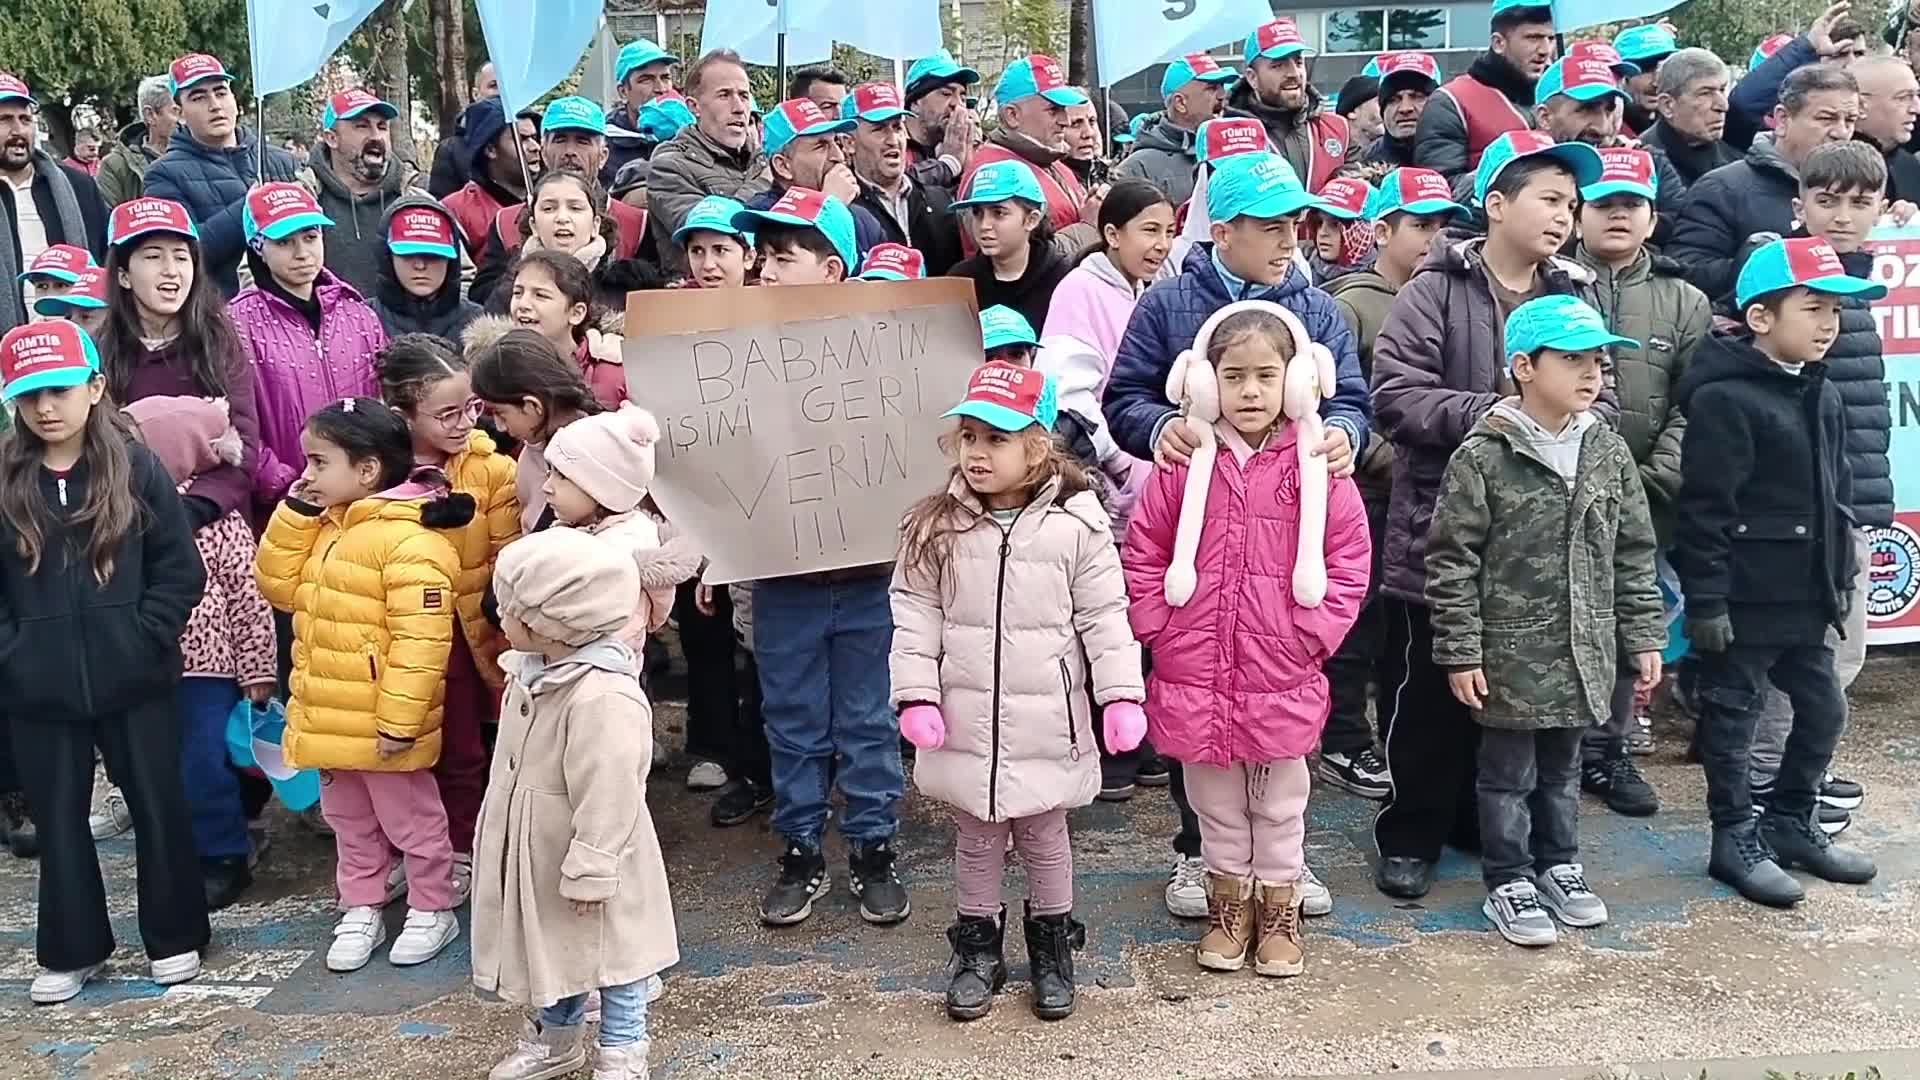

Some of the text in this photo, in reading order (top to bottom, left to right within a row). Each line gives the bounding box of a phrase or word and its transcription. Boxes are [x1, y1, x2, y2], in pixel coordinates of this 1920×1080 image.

[1220, 126, 1257, 139] TÜMTİS
[127, 201, 171, 216] TÜMTİS
[404, 212, 441, 227] TÜMTİS
[10, 333, 62, 355] TÜMTİS
[692, 321, 928, 405] BABAM'IN
[978, 366, 1025, 385] TÜMTİS
[666, 398, 752, 459] İŞİNİ
[801, 368, 922, 423] GERİ
[715, 424, 910, 520] VERİN
[793, 507, 848, 560] !!!
